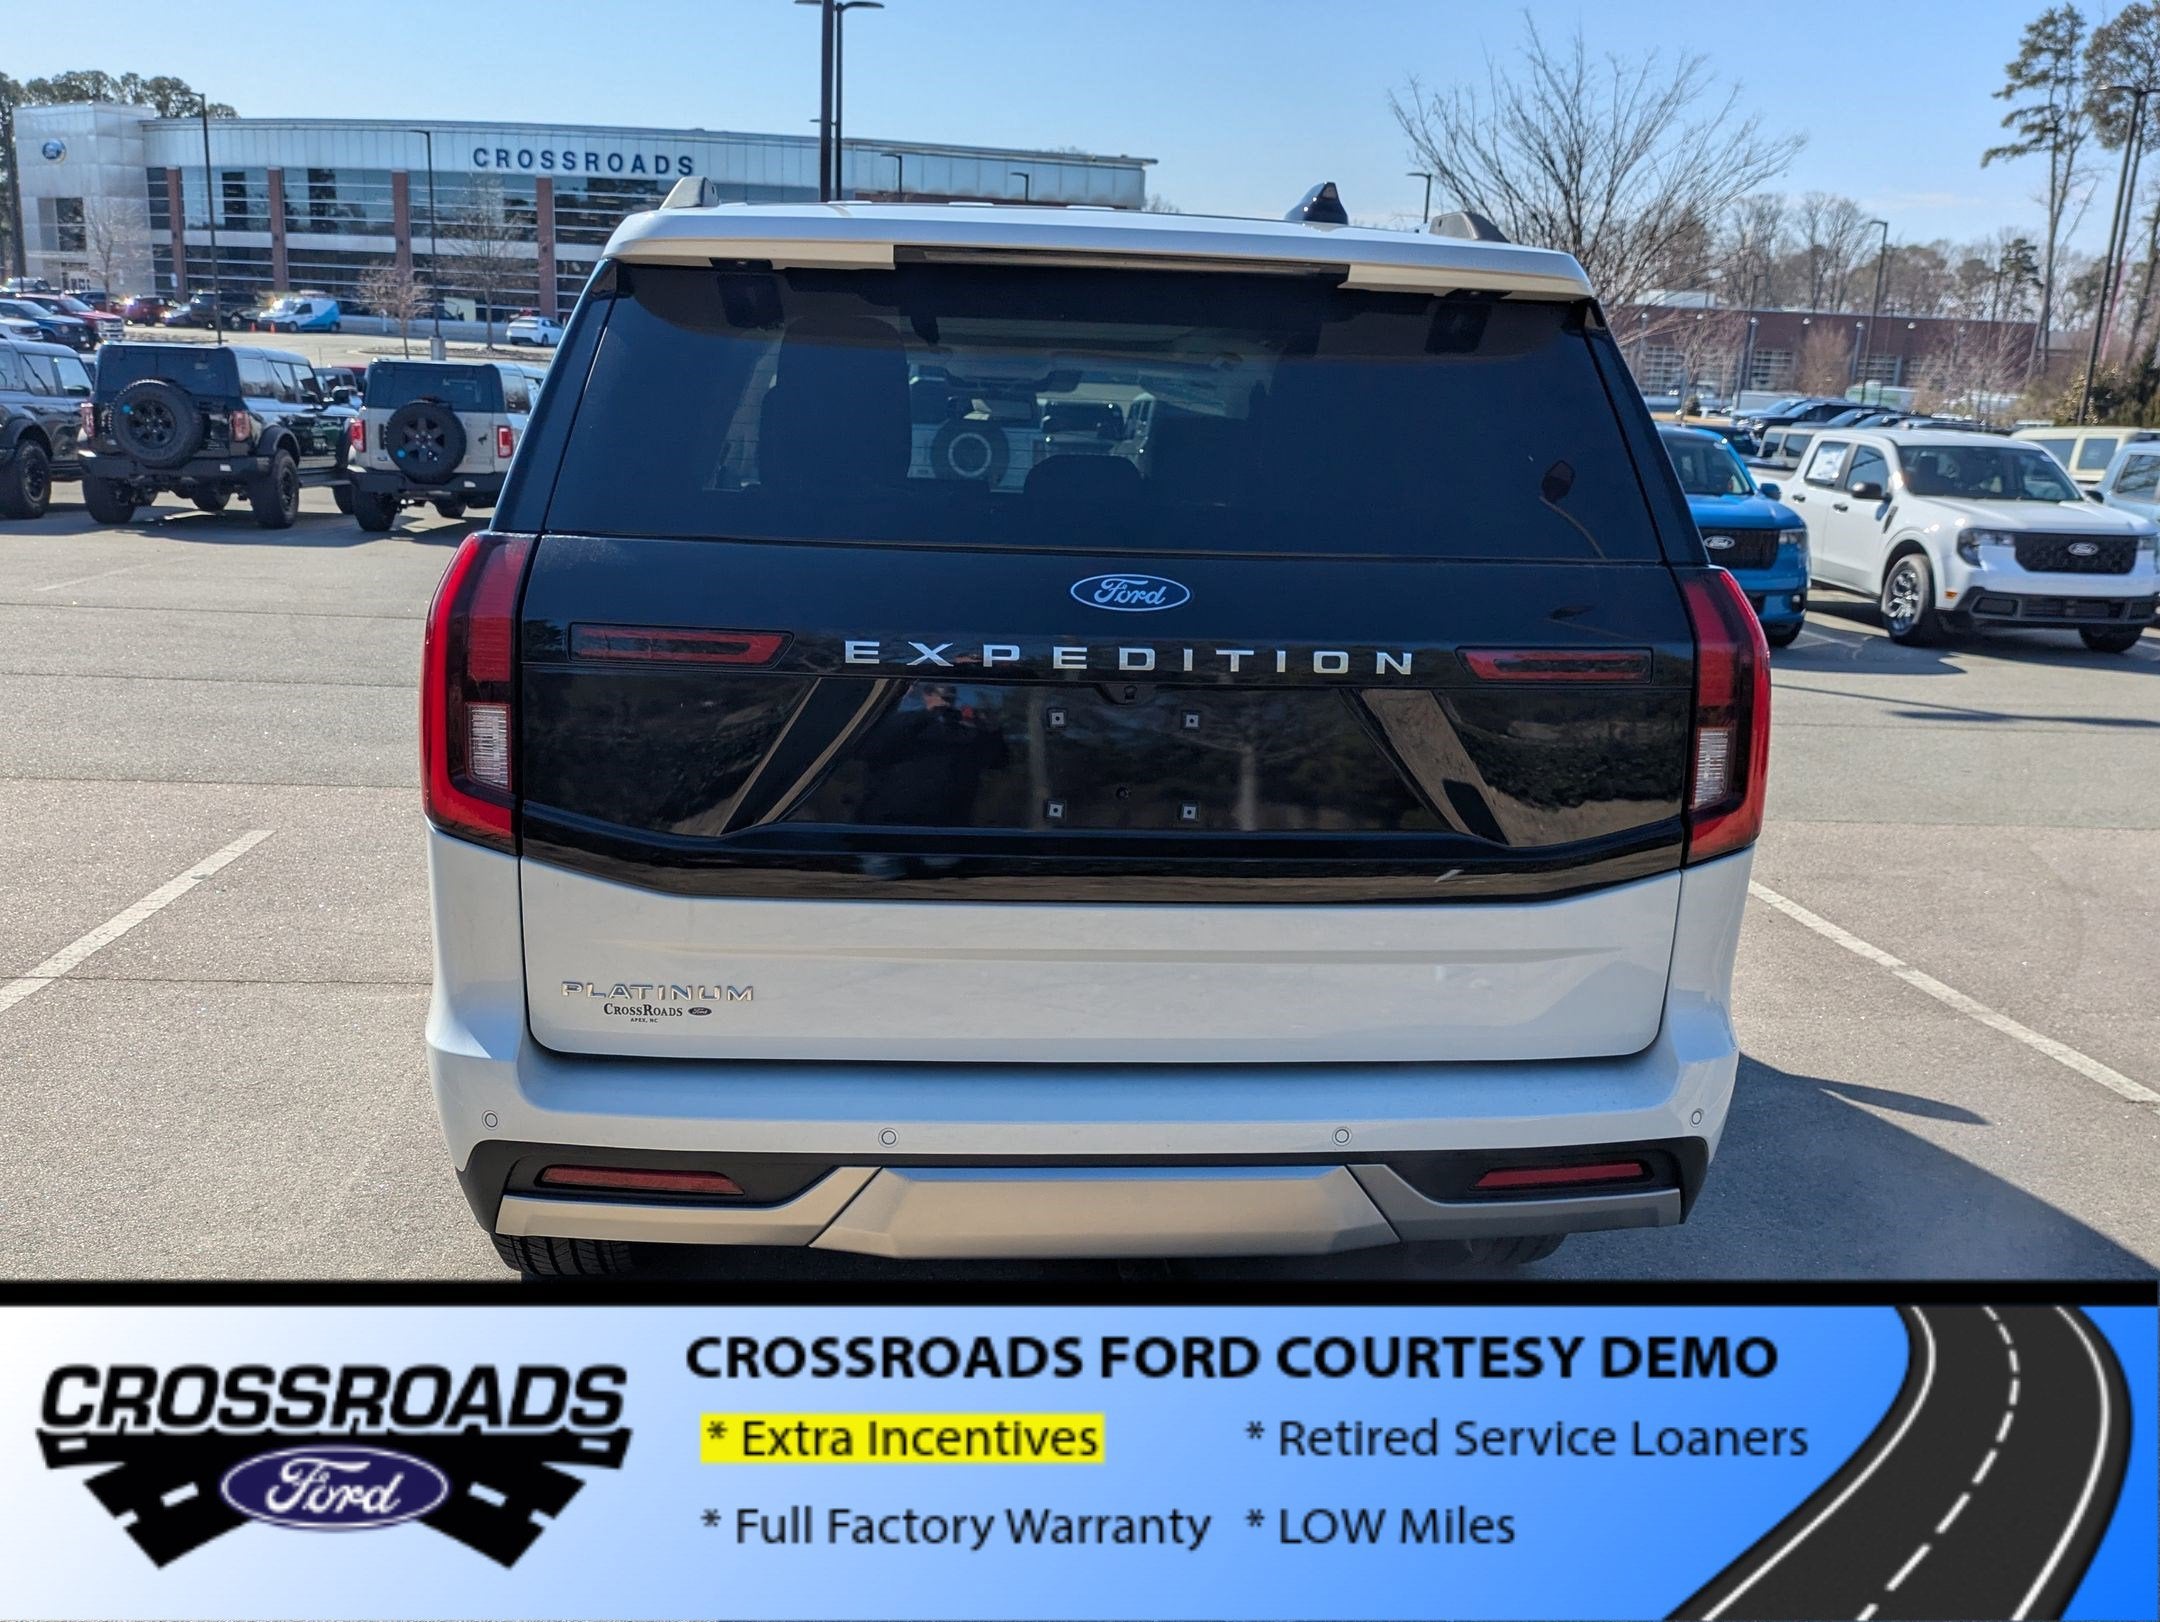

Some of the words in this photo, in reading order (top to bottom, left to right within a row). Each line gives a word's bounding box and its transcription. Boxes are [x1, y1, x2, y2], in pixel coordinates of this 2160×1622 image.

[472, 146, 695, 177] CROSSROADS
[1092, 574, 1169, 607] Ford
[844, 639, 1414, 676] EXPEDITION
[560, 980, 755, 1002] PLATINUM
